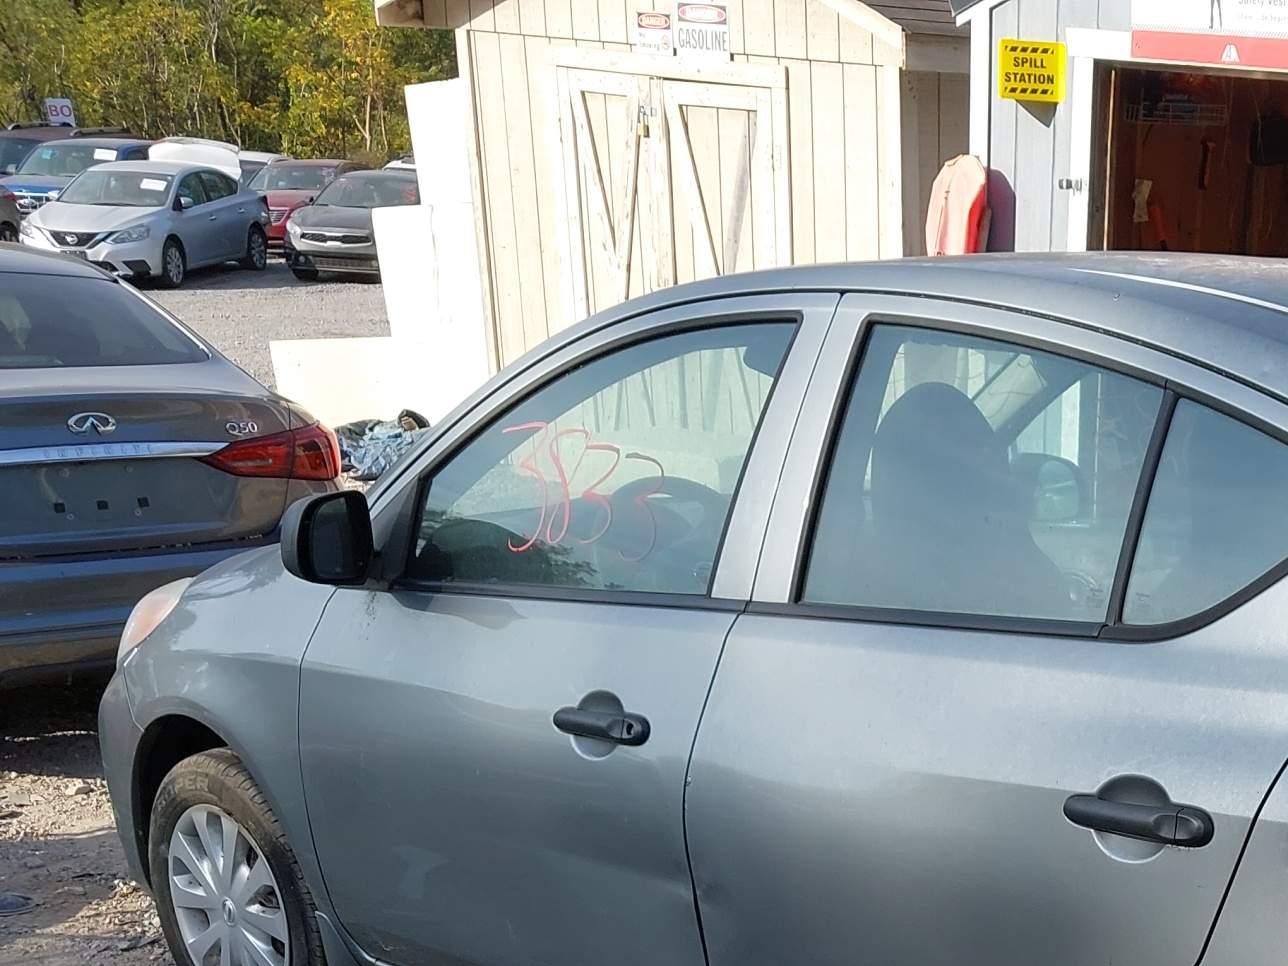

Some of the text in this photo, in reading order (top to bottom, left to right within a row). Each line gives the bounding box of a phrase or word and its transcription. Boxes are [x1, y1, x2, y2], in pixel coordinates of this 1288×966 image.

[678, 28, 728, 52] GASOLINE
[1013, 56, 1047, 69] SPILL
[1004, 72, 1055, 85] STATION
[226, 421, 258, 436] Q50
